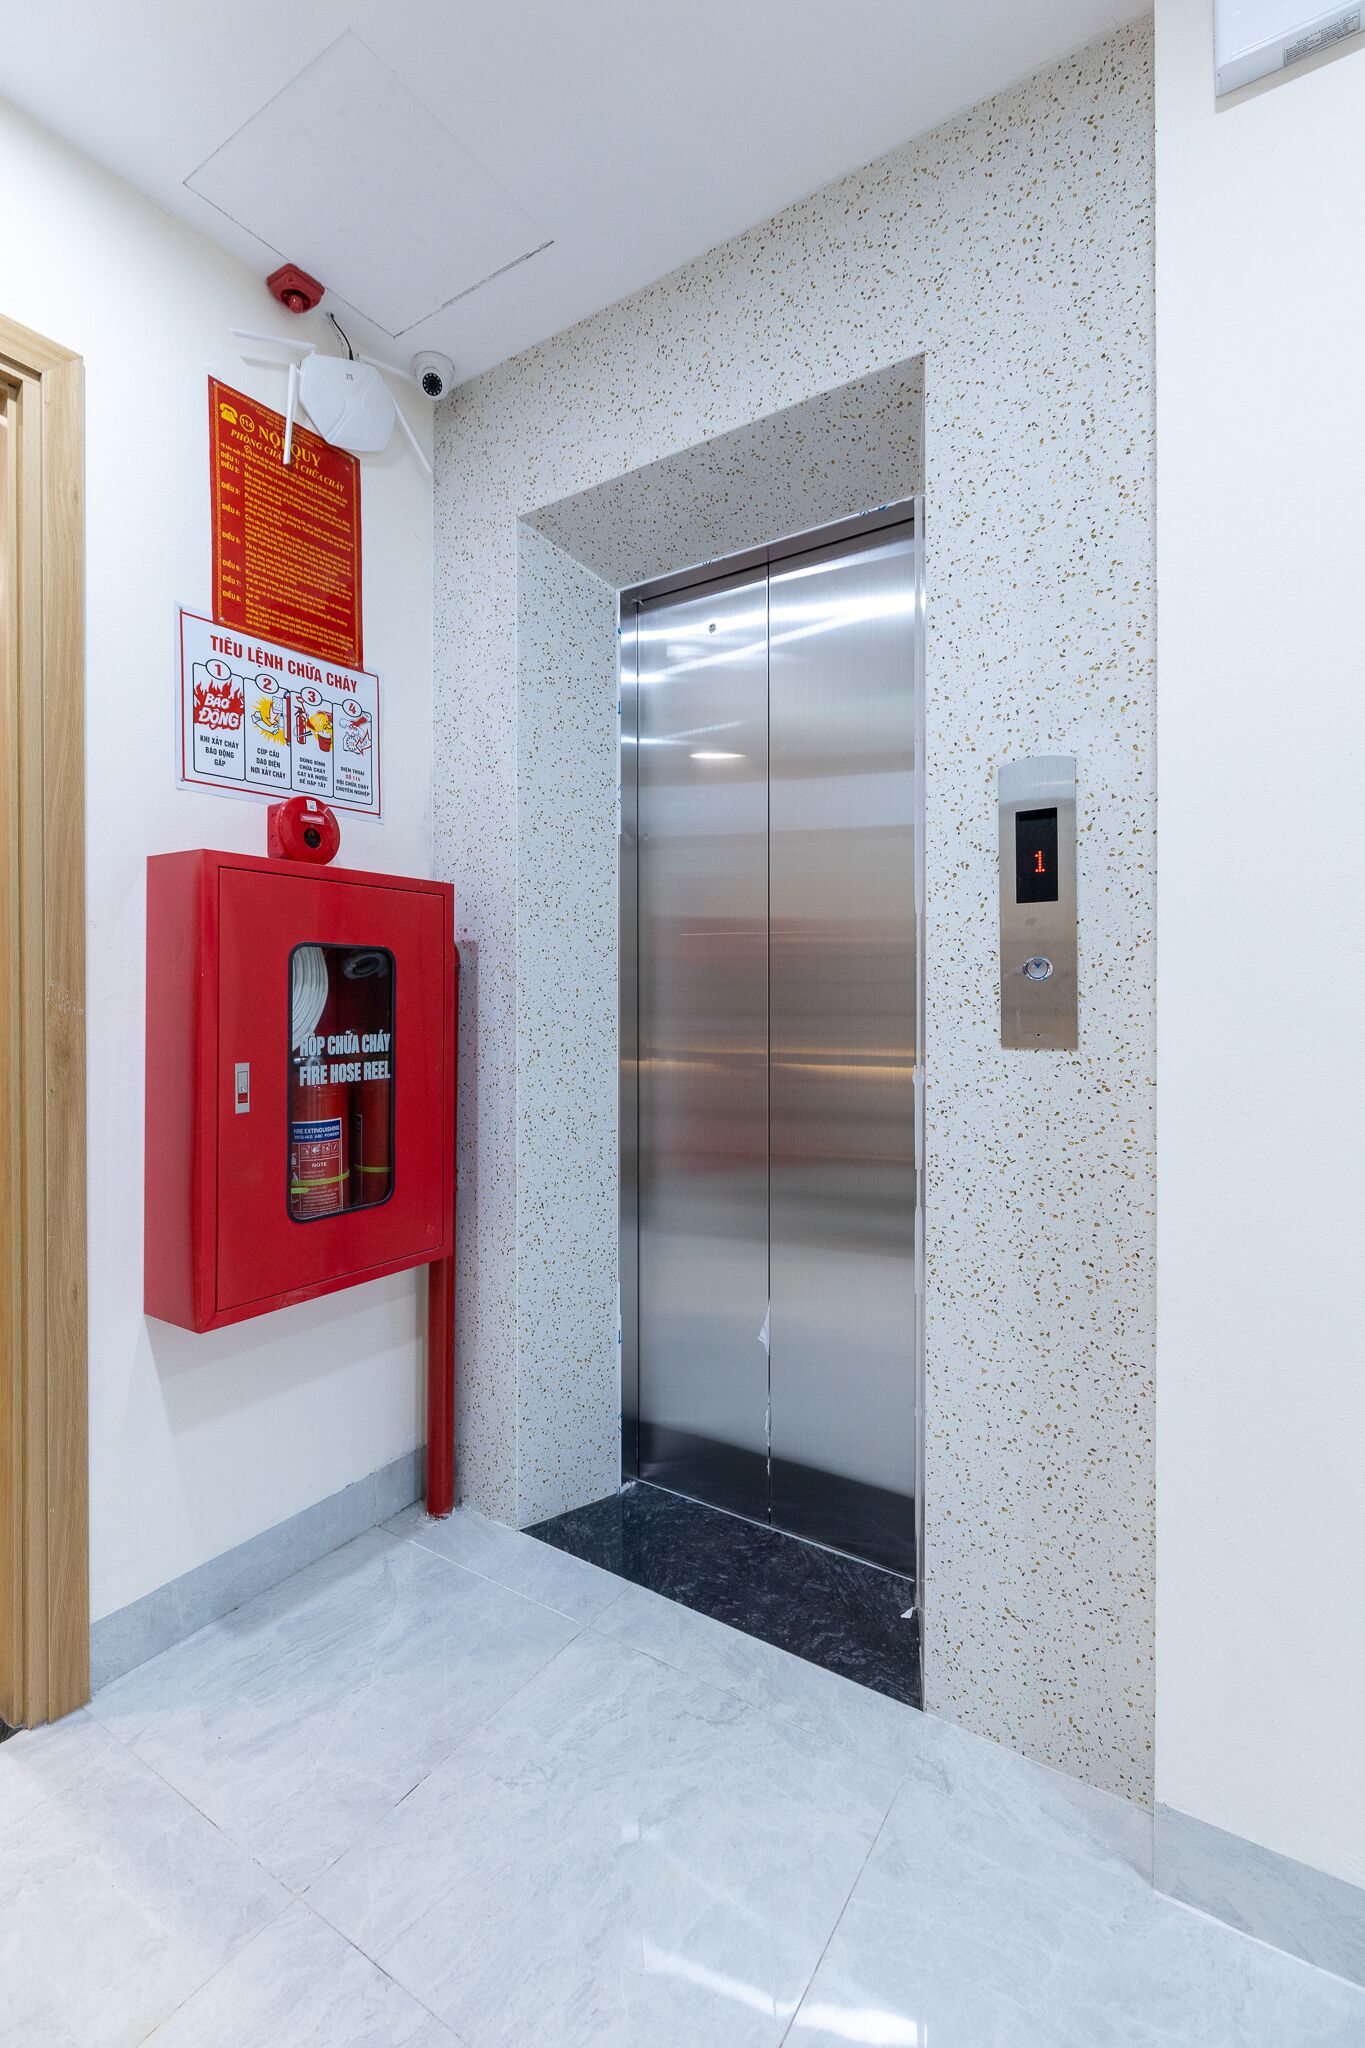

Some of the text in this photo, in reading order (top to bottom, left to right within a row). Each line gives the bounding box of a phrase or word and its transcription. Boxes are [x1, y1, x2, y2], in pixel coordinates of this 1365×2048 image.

[231, 429, 262, 450] PHÒNG
[324, 477, 344, 492] CHÁY
[291, 443, 320, 467] QUY
[210, 635, 357, 693] TIÊU LỆNH CHỮA CHÁY
[215, 664, 221, 676] 1
[263, 678, 272, 691] 2
[308, 691, 316, 703] 3
[199, 707, 239, 729] ĐỘNG
[349, 703, 356, 714] 4
[200, 734, 210, 743] KHI
[224, 740, 239, 749] CHÁY
[219, 749, 234, 759] ĐỘNG
[1035, 851, 1045, 872] 1
[328, 1030, 359, 1055] CHỮA
[362, 1029, 390, 1053] CHÁY
[300, 1061, 390, 1086] FIRE HOSE REEL
